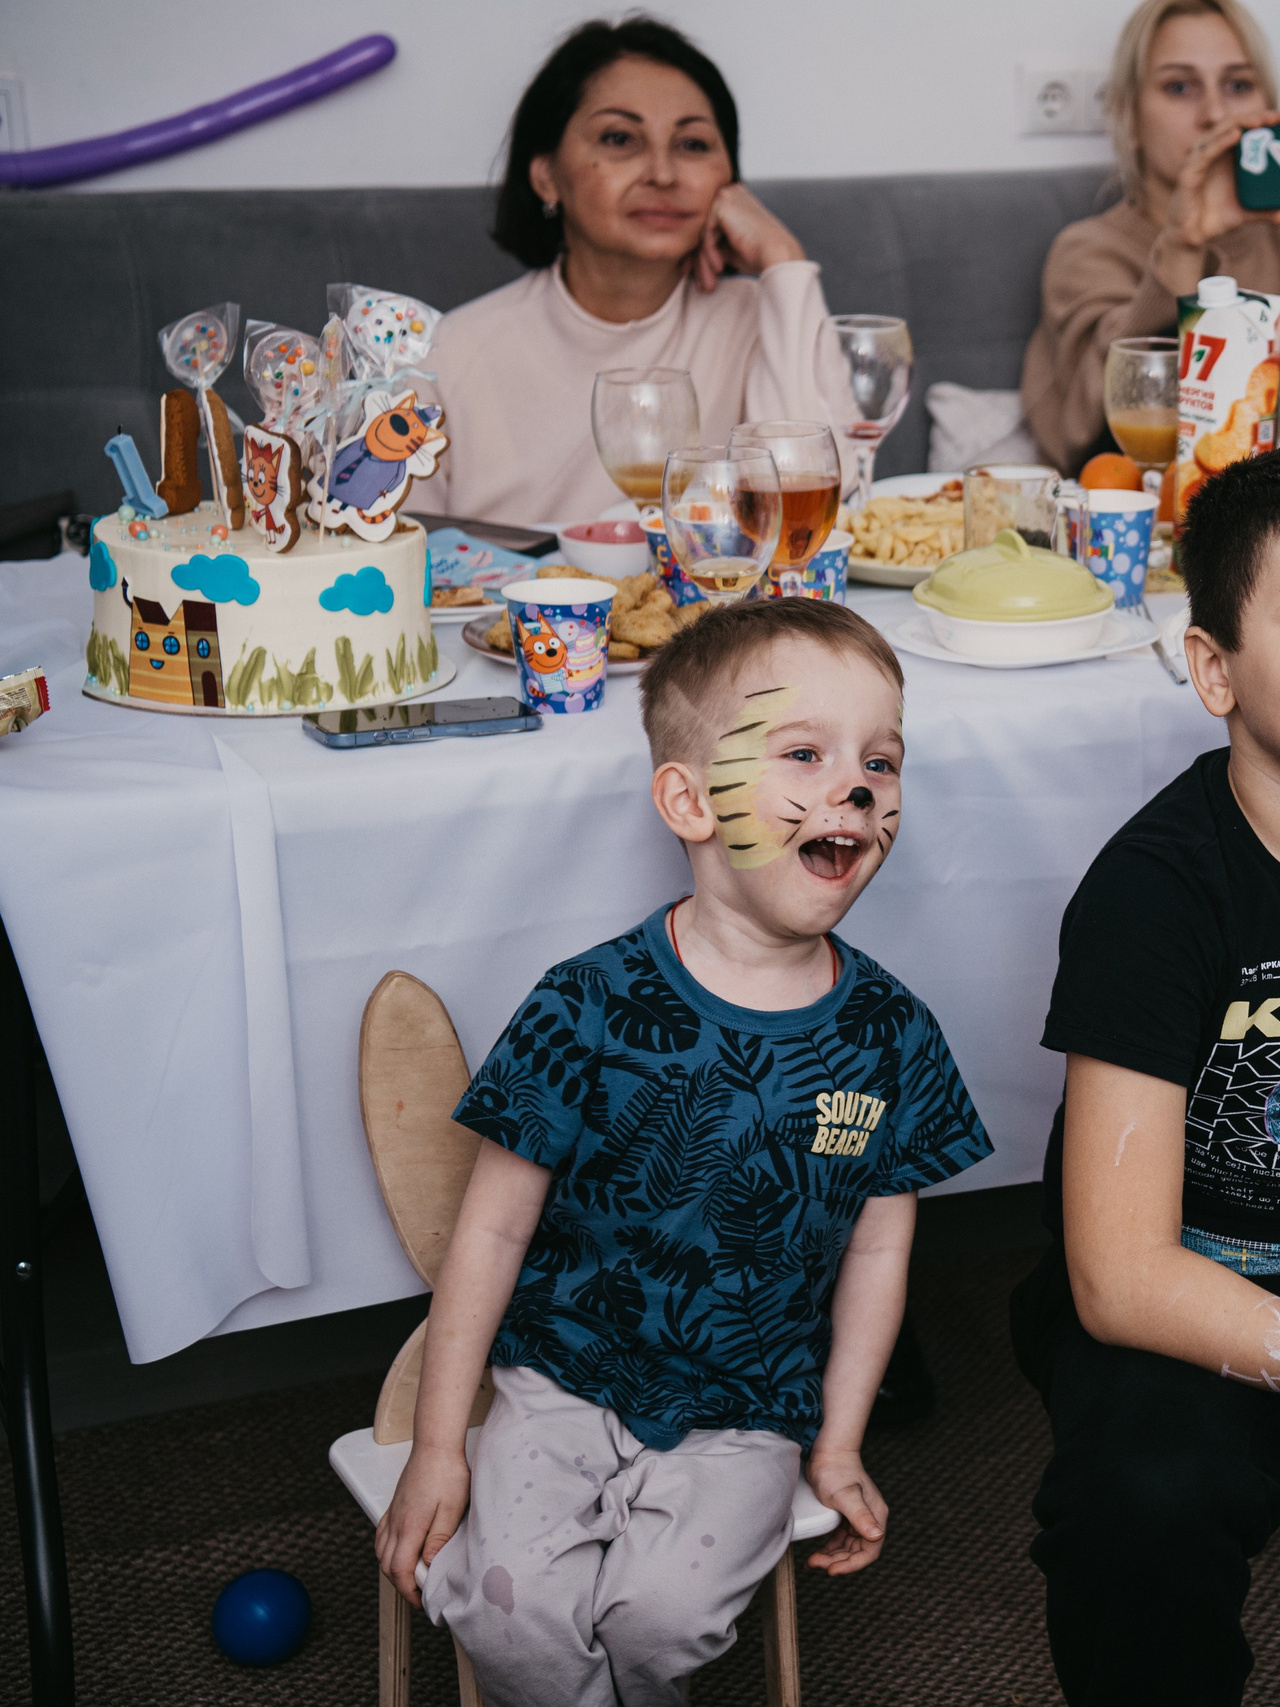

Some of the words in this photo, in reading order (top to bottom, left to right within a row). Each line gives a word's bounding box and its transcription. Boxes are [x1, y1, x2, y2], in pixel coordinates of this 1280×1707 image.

[815, 1090, 886, 1131] SOUTH
[810, 1125, 870, 1156] BEACH
[1225, 1160, 1247, 1171] cell
